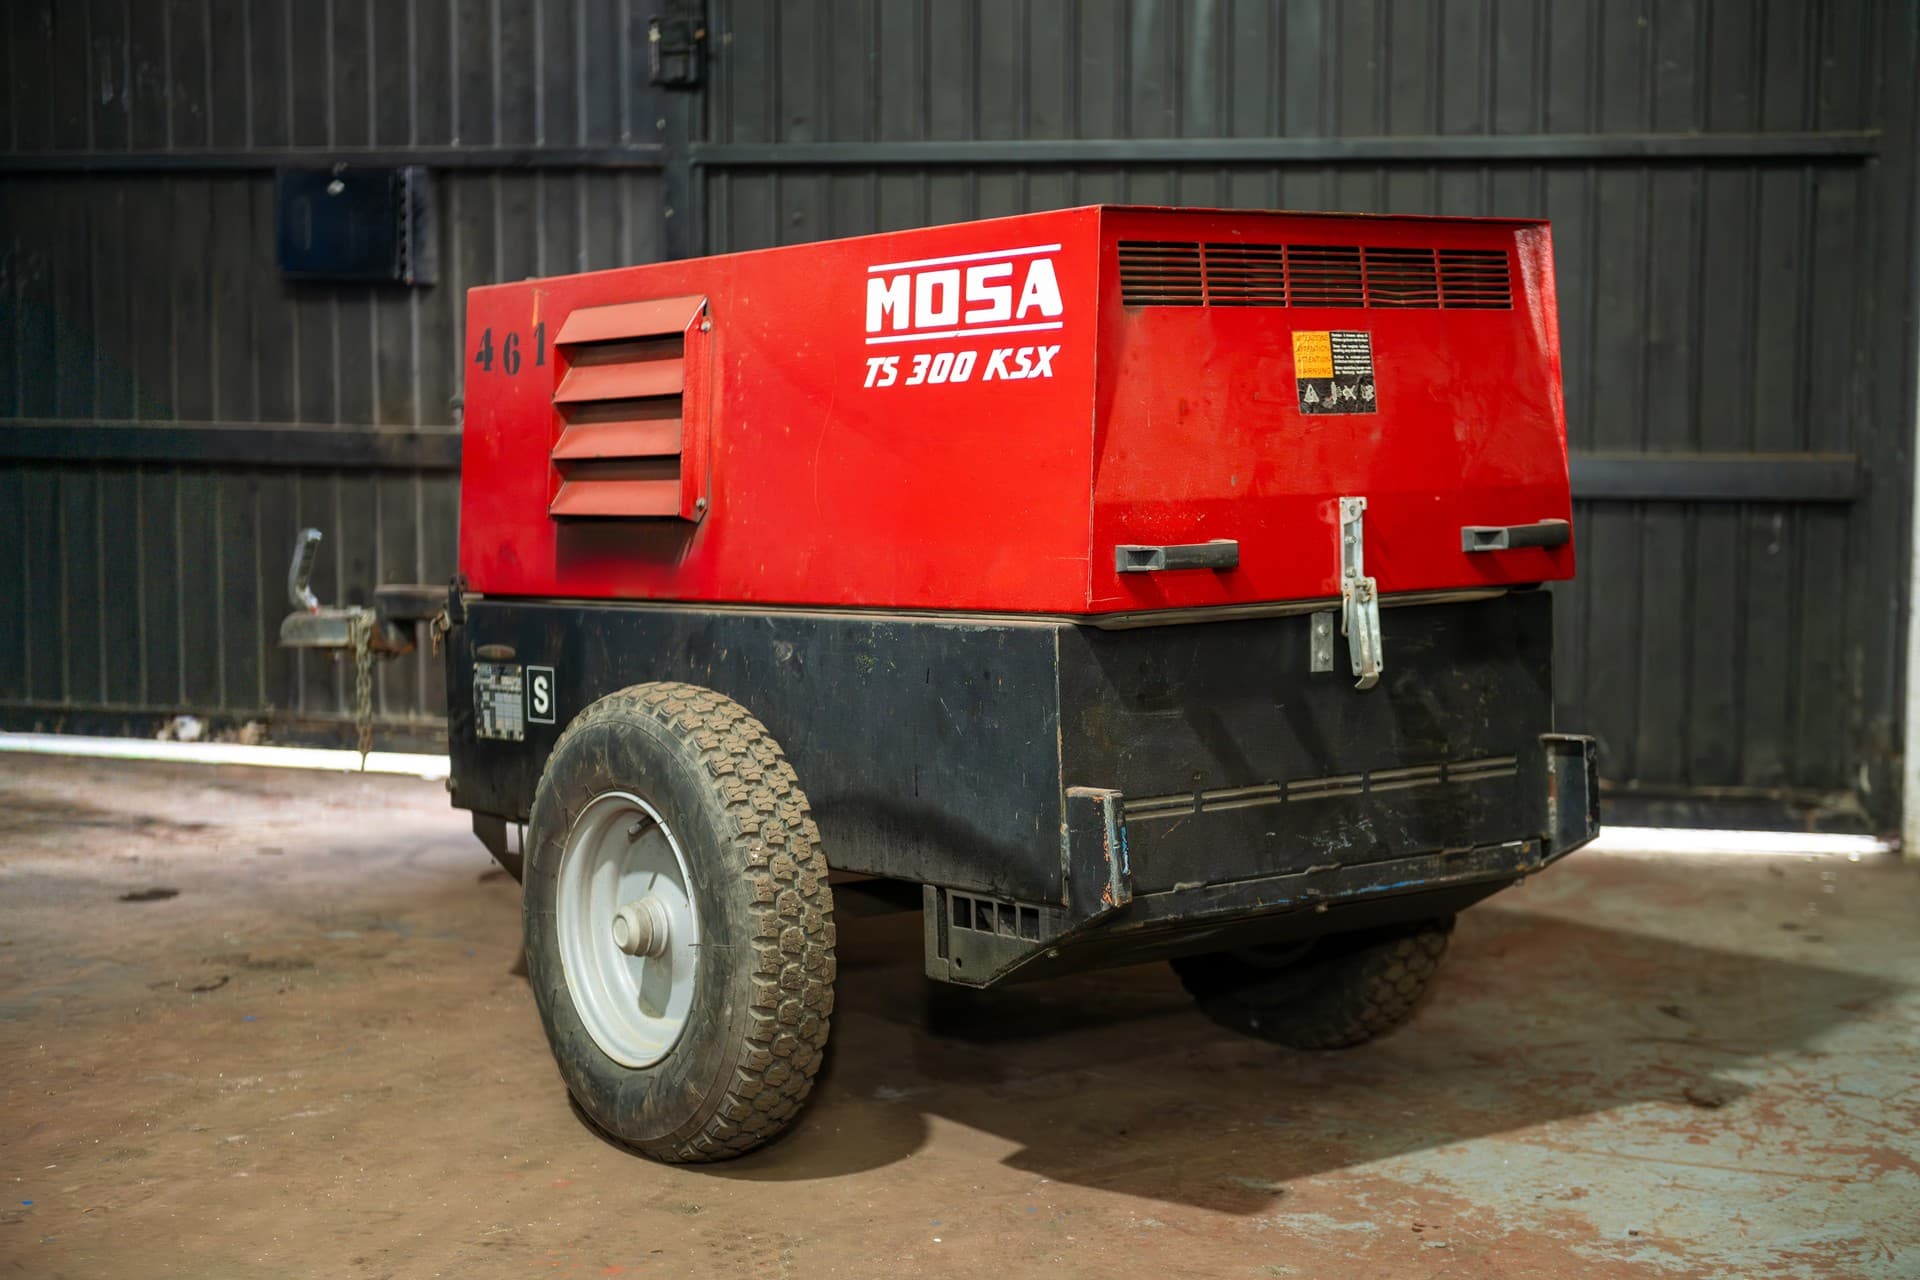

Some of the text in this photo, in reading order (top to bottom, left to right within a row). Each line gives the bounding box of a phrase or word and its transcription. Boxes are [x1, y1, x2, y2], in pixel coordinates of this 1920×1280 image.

[865, 258, 1063, 333] MOSA
[475, 322, 545, 376] 461
[864, 345, 1060, 388] TS 300 KSX
[534, 675, 549, 714] S
